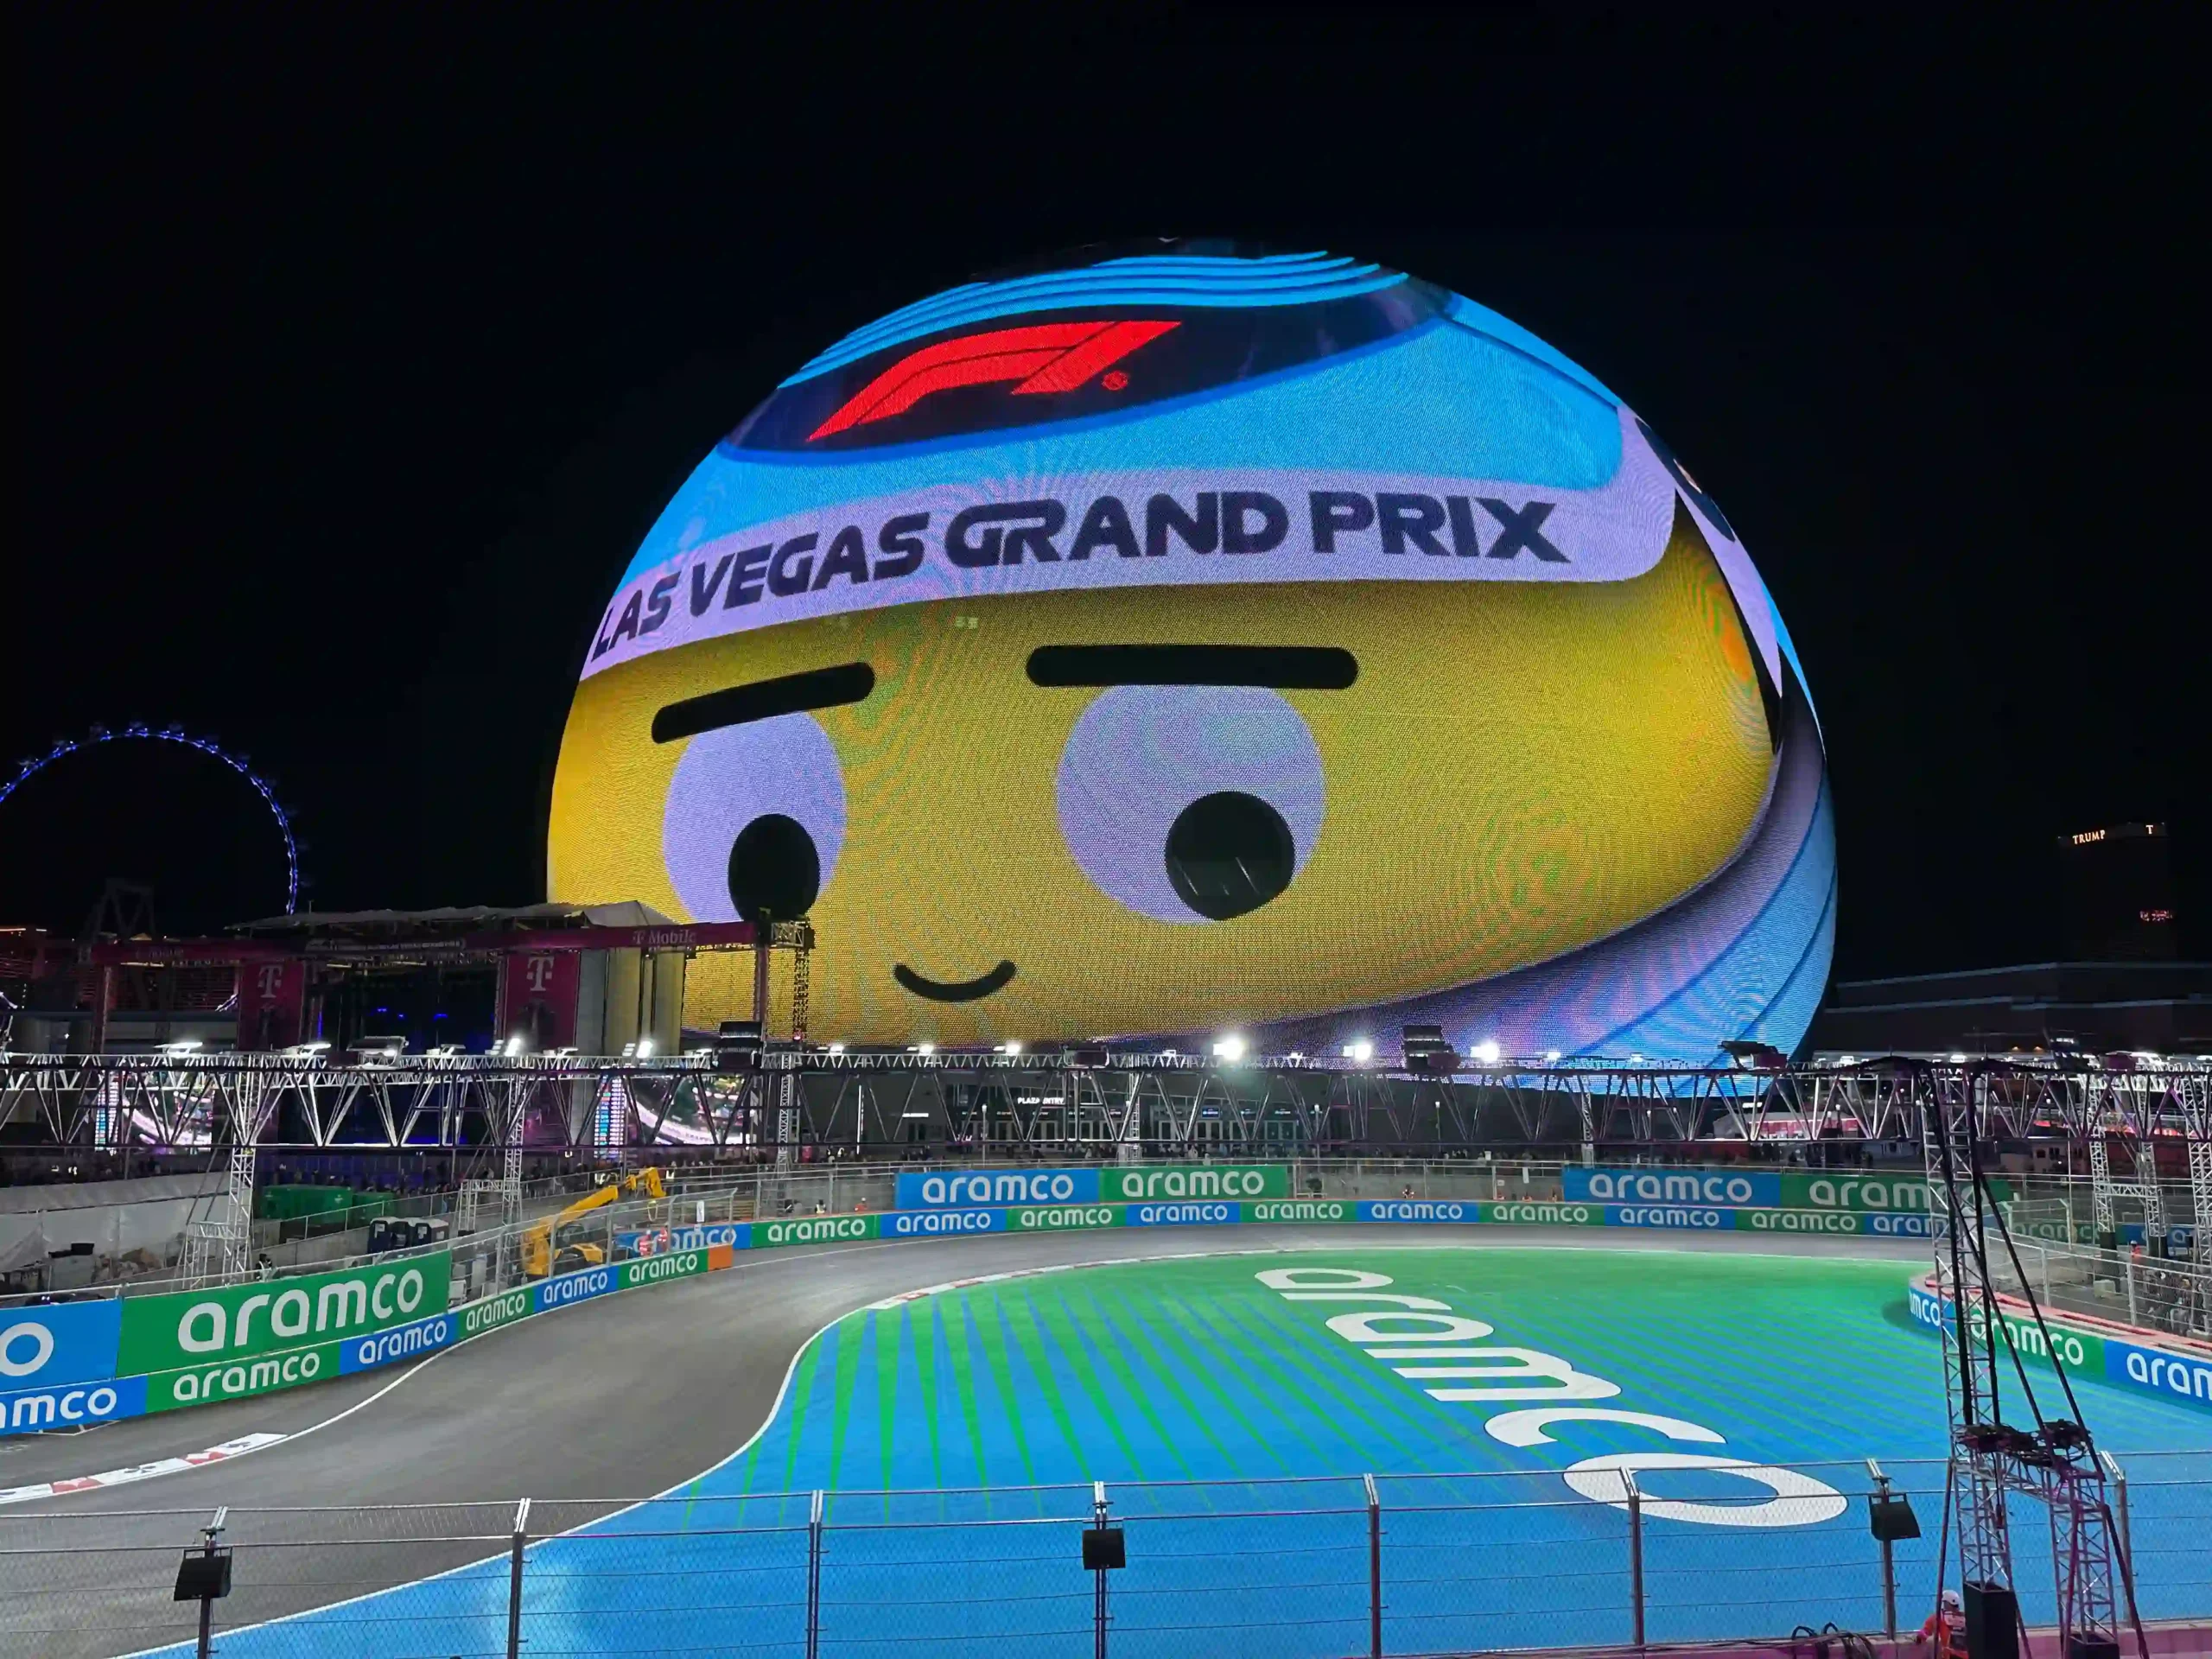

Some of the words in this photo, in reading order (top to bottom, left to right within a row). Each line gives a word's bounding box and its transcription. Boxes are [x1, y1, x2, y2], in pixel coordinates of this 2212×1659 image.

[591, 571, 682, 663] LAS
[690, 512, 932, 617] VEGAS
[944, 491, 1289, 569] GRAND
[1308, 491, 1571, 563] PRIX
[2072, 830, 2106, 845] TRUMP
[923, 1174, 1073, 1204] aramco
[1122, 1171, 1264, 1201] aramco
[1588, 1173, 1752, 1203] aramco
[897, 1211, 991, 1233] aramco
[1020, 1208, 1113, 1227] aramco
[1141, 1202, 1228, 1223] aramco
[1255, 1201, 1343, 1221] aramco
[1371, 1202, 1463, 1221] aramco
[1493, 1204, 1589, 1224] aramco
[1618, 1206, 1719, 1228] aramco
[1751, 1211, 1857, 1232] aramco
[767, 1219, 866, 1243] aramco
[629, 1253, 697, 1283] aramco
[543, 1271, 608, 1305] aramco
[177, 1269, 423, 1353] aramco
[466, 1294, 525, 1332] aramco
[358, 1319, 448, 1364] aramco
[173, 1352, 321, 1402] aramco
[1254, 1268, 1848, 1527] aramco
